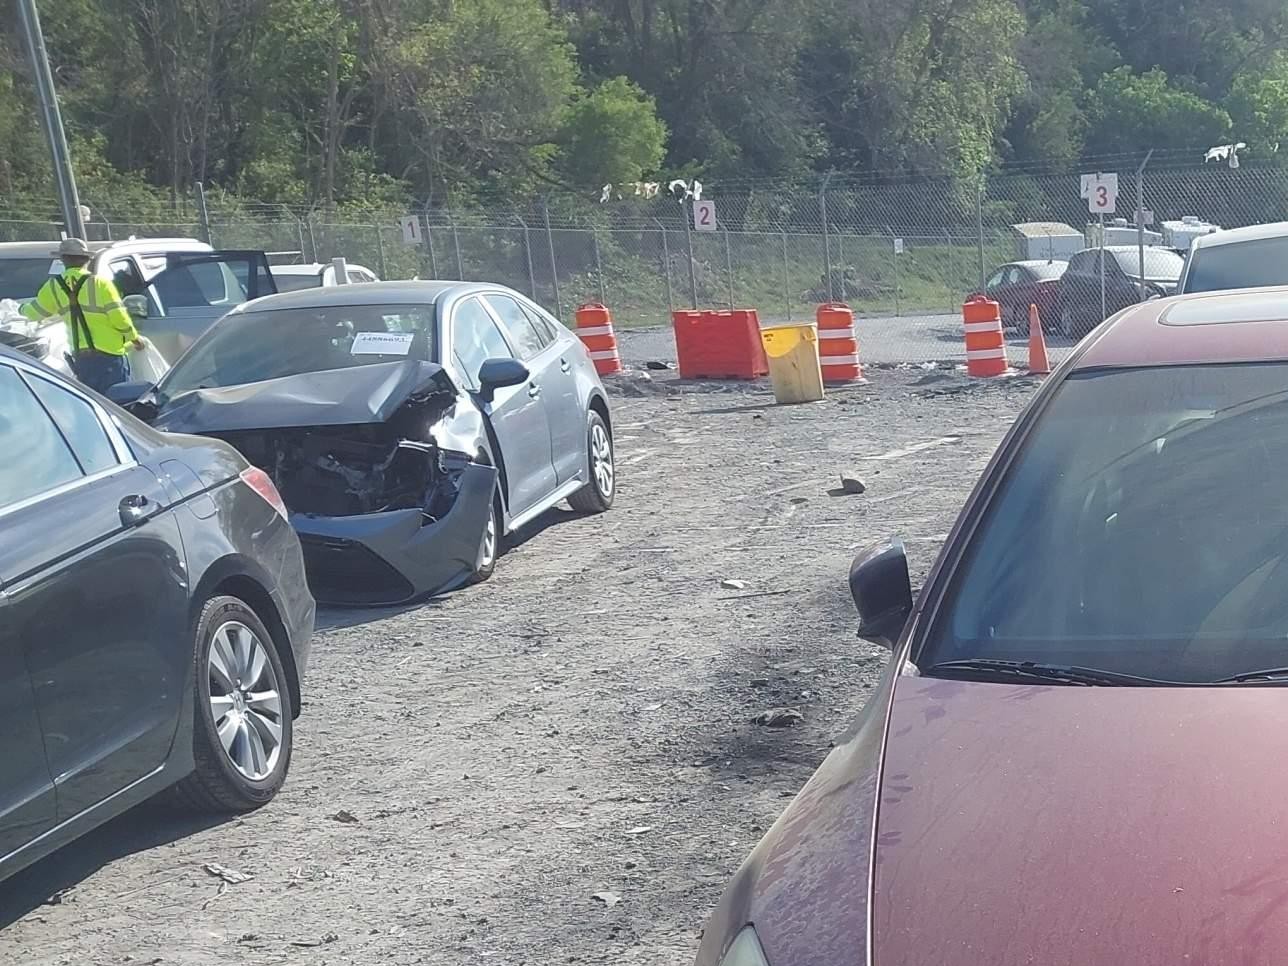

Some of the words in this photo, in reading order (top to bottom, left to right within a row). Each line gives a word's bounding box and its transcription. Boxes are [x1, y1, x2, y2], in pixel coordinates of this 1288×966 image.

[1096, 186, 1108, 207] 3
[699, 206, 711, 226] 2
[407, 221, 416, 239] 1
